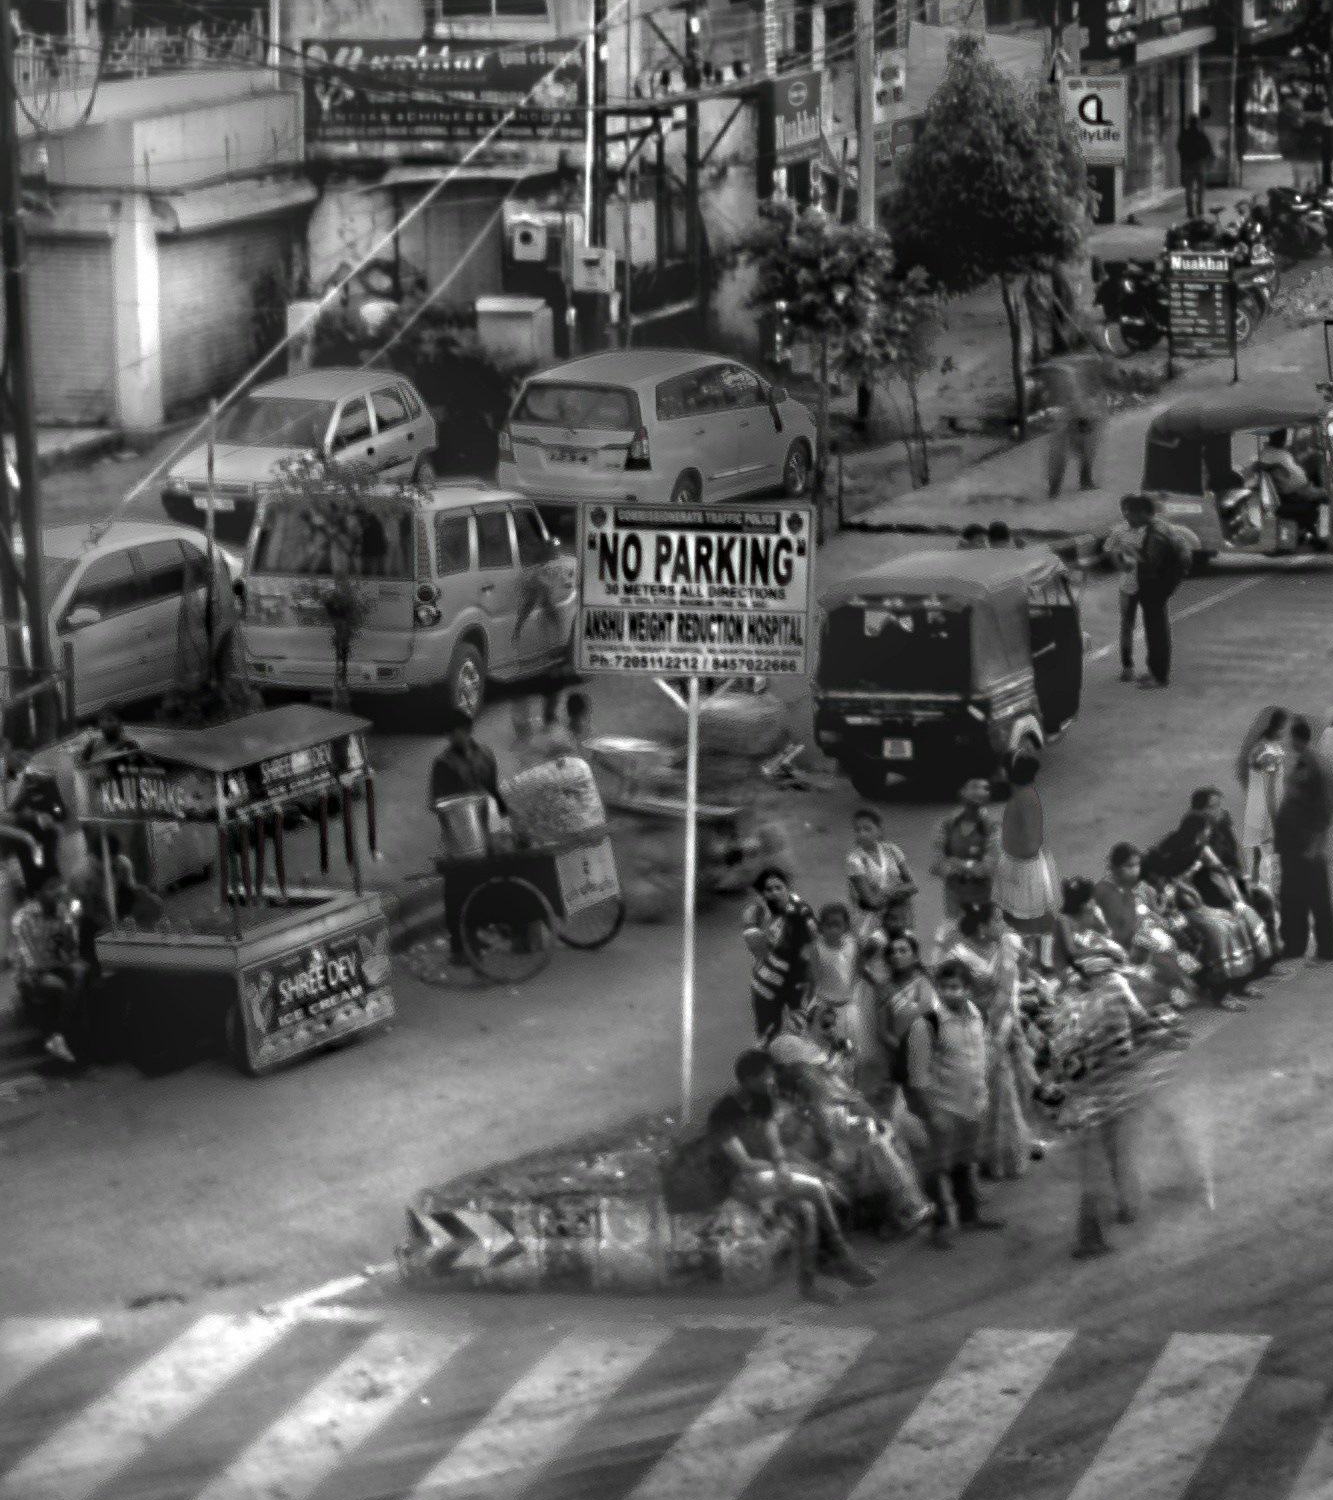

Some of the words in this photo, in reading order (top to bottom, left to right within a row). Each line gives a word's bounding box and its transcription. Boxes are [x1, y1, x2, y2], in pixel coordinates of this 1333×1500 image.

[1171, 256, 1229, 270] Nuakhai
[605, 584, 619, 596] 30
[623, 584, 676, 597] METERS
[680, 586, 704, 598] ALL
[708, 586, 787, 600] DIRECTIONS
[584, 611, 625, 640] ANSHU
[628, 611, 674, 642] WEIGHT
[677, 612, 743, 644] REDUCTION
[748, 614, 804, 646] HOSPITAL
[102, 777, 137, 812] KAJU
[278, 963, 327, 1006] SHREE
[327, 952, 357, 986] DEV
[278, 1008, 305, 1027] ICE
[308, 983, 364, 1015] CREAM
